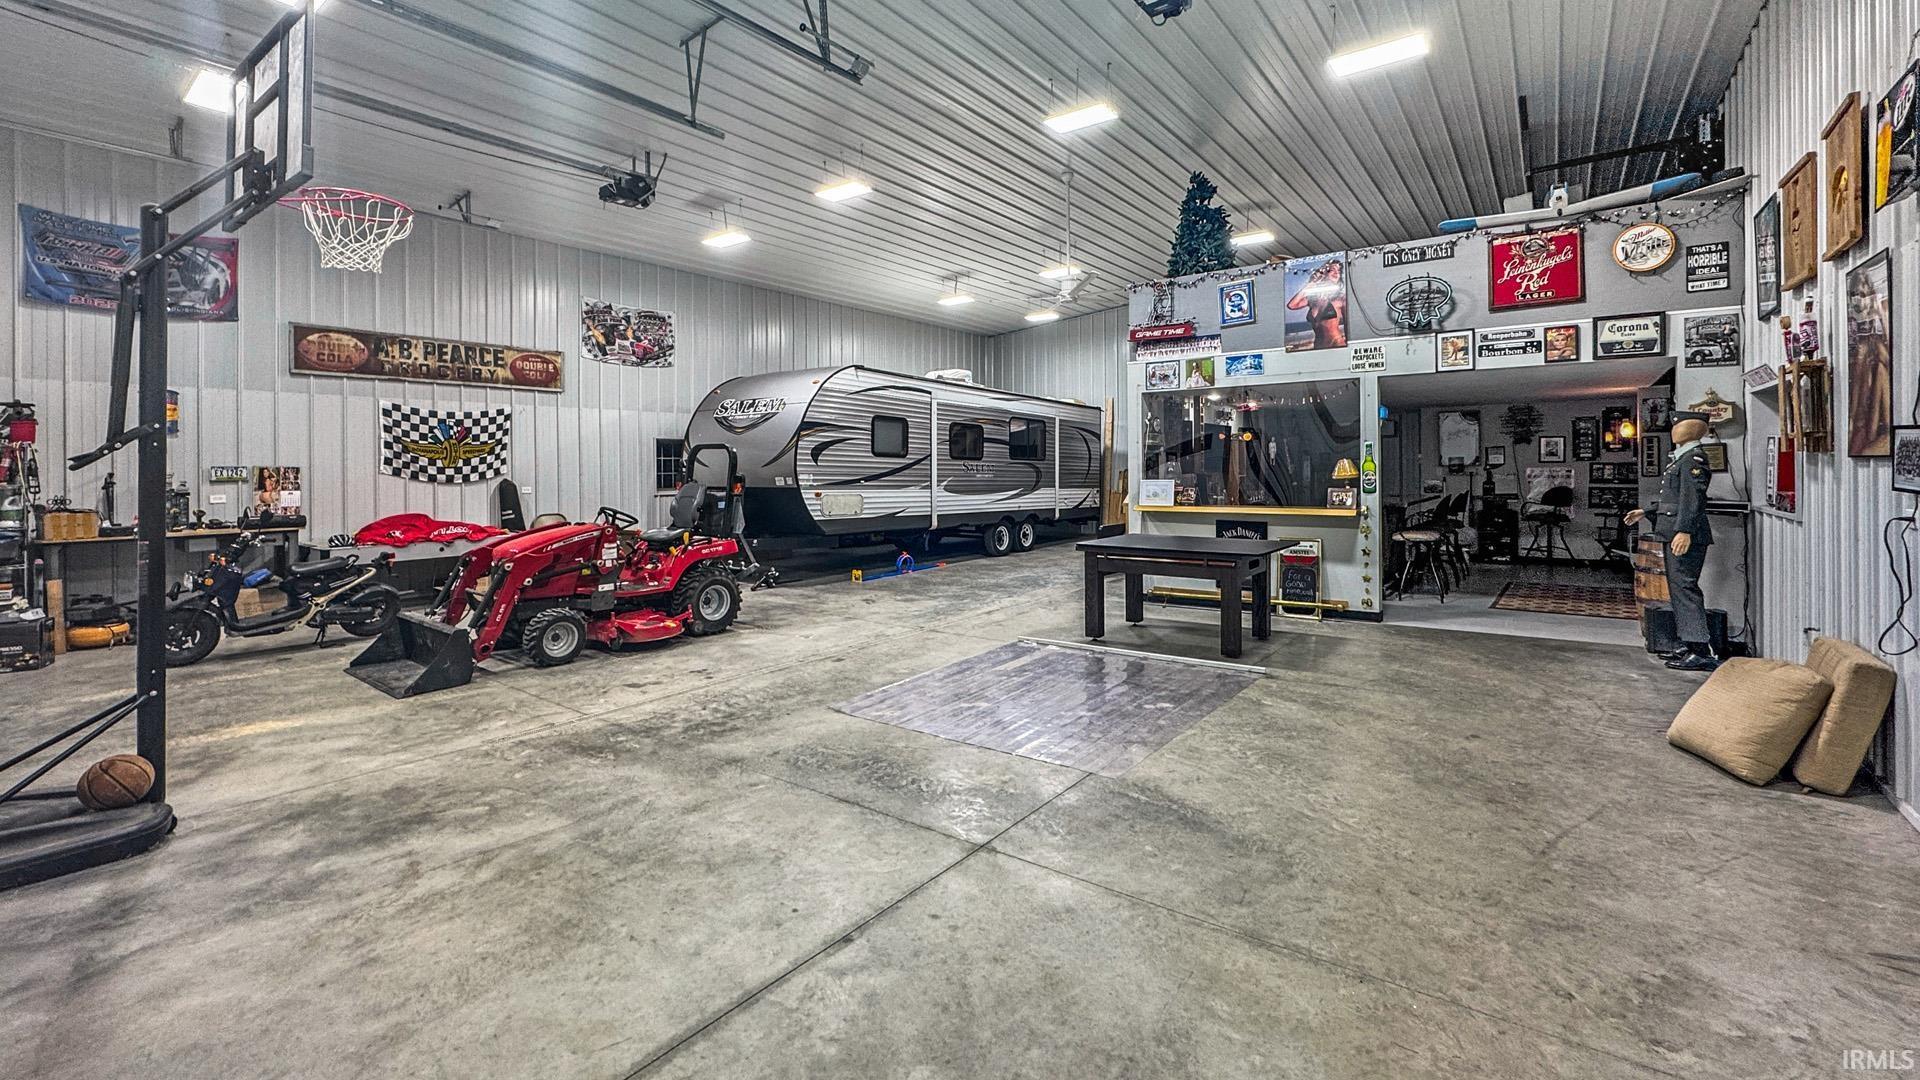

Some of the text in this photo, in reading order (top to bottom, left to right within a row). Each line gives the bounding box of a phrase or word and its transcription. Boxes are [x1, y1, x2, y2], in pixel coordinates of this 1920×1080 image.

[1497, 246, 1573, 283] Leinenkugel's
[1688, 251, 1728, 268] HORRIBLE
[64, 260, 122, 275] NATIONAL
[1514, 271, 1550, 295] Red
[1518, 291, 1553, 300] LAGER
[1135, 330, 1162, 338] GAME
[1607, 323, 1649, 335] Corona
[422, 341, 505, 368] PEARCE
[1352, 353, 1384, 361] PICKPOCKETS
[1481, 348, 1523, 357] Bourbon
[1351, 362, 1366, 370] LOOSE
[713, 398, 786, 417] SALEM
